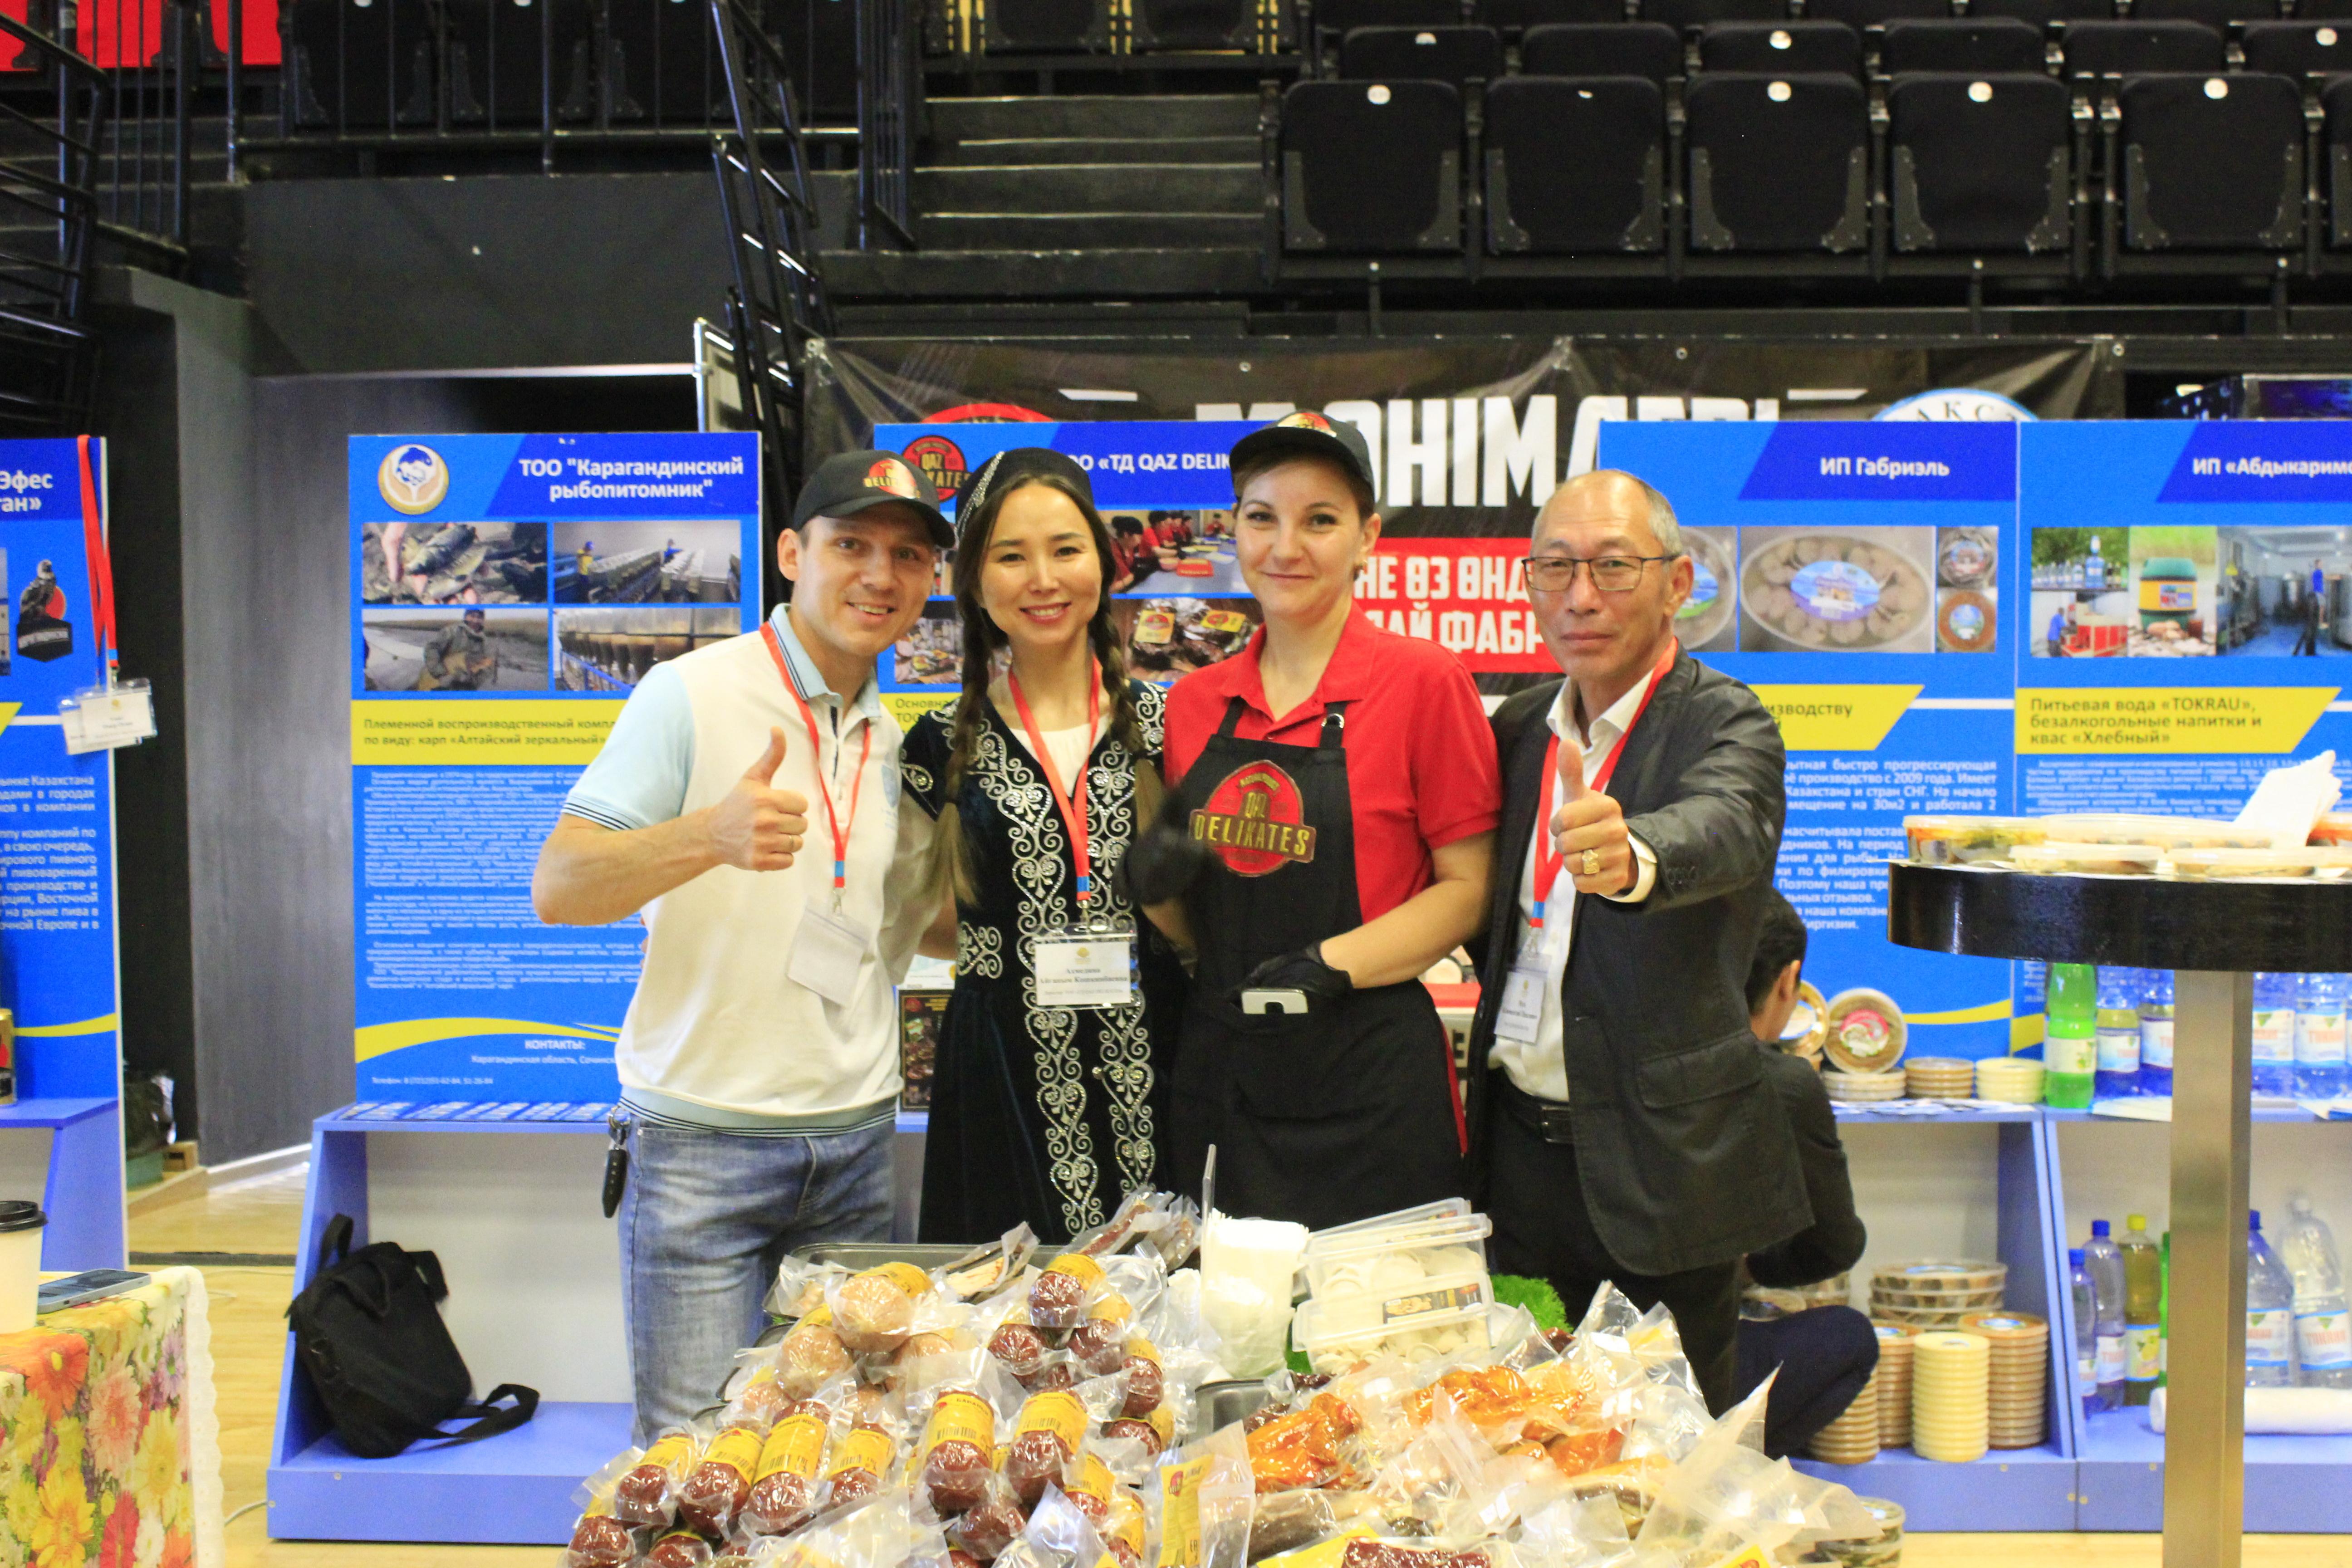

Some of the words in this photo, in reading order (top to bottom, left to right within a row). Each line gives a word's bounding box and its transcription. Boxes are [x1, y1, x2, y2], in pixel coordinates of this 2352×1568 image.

[519, 459, 562, 477] ТОО
[567, 456, 744, 484] "Карагандинский
[1098, 455, 1135, 474] «ТД
[1138, 454, 1177, 472] QAZ
[1820, 458, 1851, 476] ИП
[1856, 456, 1950, 480] Габриэль
[2193, 459, 2220, 475] ИП
[549, 479, 713, 503] рыбопитомник"
[0, 496, 42, 512] ан»
[1405, 555, 1450, 599] ӨЗ
[2030, 698, 2110, 712] Питьевая
[2116, 700, 2156, 713] вода
[2161, 696, 2255, 713] «TOKRAU»,
[364, 717, 434, 730] Племенной
[437, 717, 573, 732] воспроизводственный
[2030, 715, 2171, 729] безалкогольные
[2177, 715, 2246, 727] напитки
[2251, 716, 2262, 727] и
[364, 737, 379, 745] по
[382, 736, 415, 748] виду:
[418, 736, 447, 748] карп
[450, 732, 521, 745] «Алтайский
[2030, 732, 2067, 745] квас
[2072, 729, 2170, 745] «Хлебный»
[1833, 759, 1877, 772] быстро
[1884, 761, 1997, 773] прогрессирующая
[1799, 774, 1882, 785] производство
[1893, 772, 1923, 784] 2009
[1958, 772, 1997, 784] Имеет
[1855, 789, 1862, 797] и
[1933, 787, 1949, 797] На
[1953, 788, 1997, 798] начало
[1852, 801, 1867, 810] на
[1926, 799, 1982, 812] работала
[1194, 814, 1310, 856] DELIKATES
[1802, 919, 1859, 931] иргизии.
[524, 1039, 586, 1050] КОНТАКТЫ:
